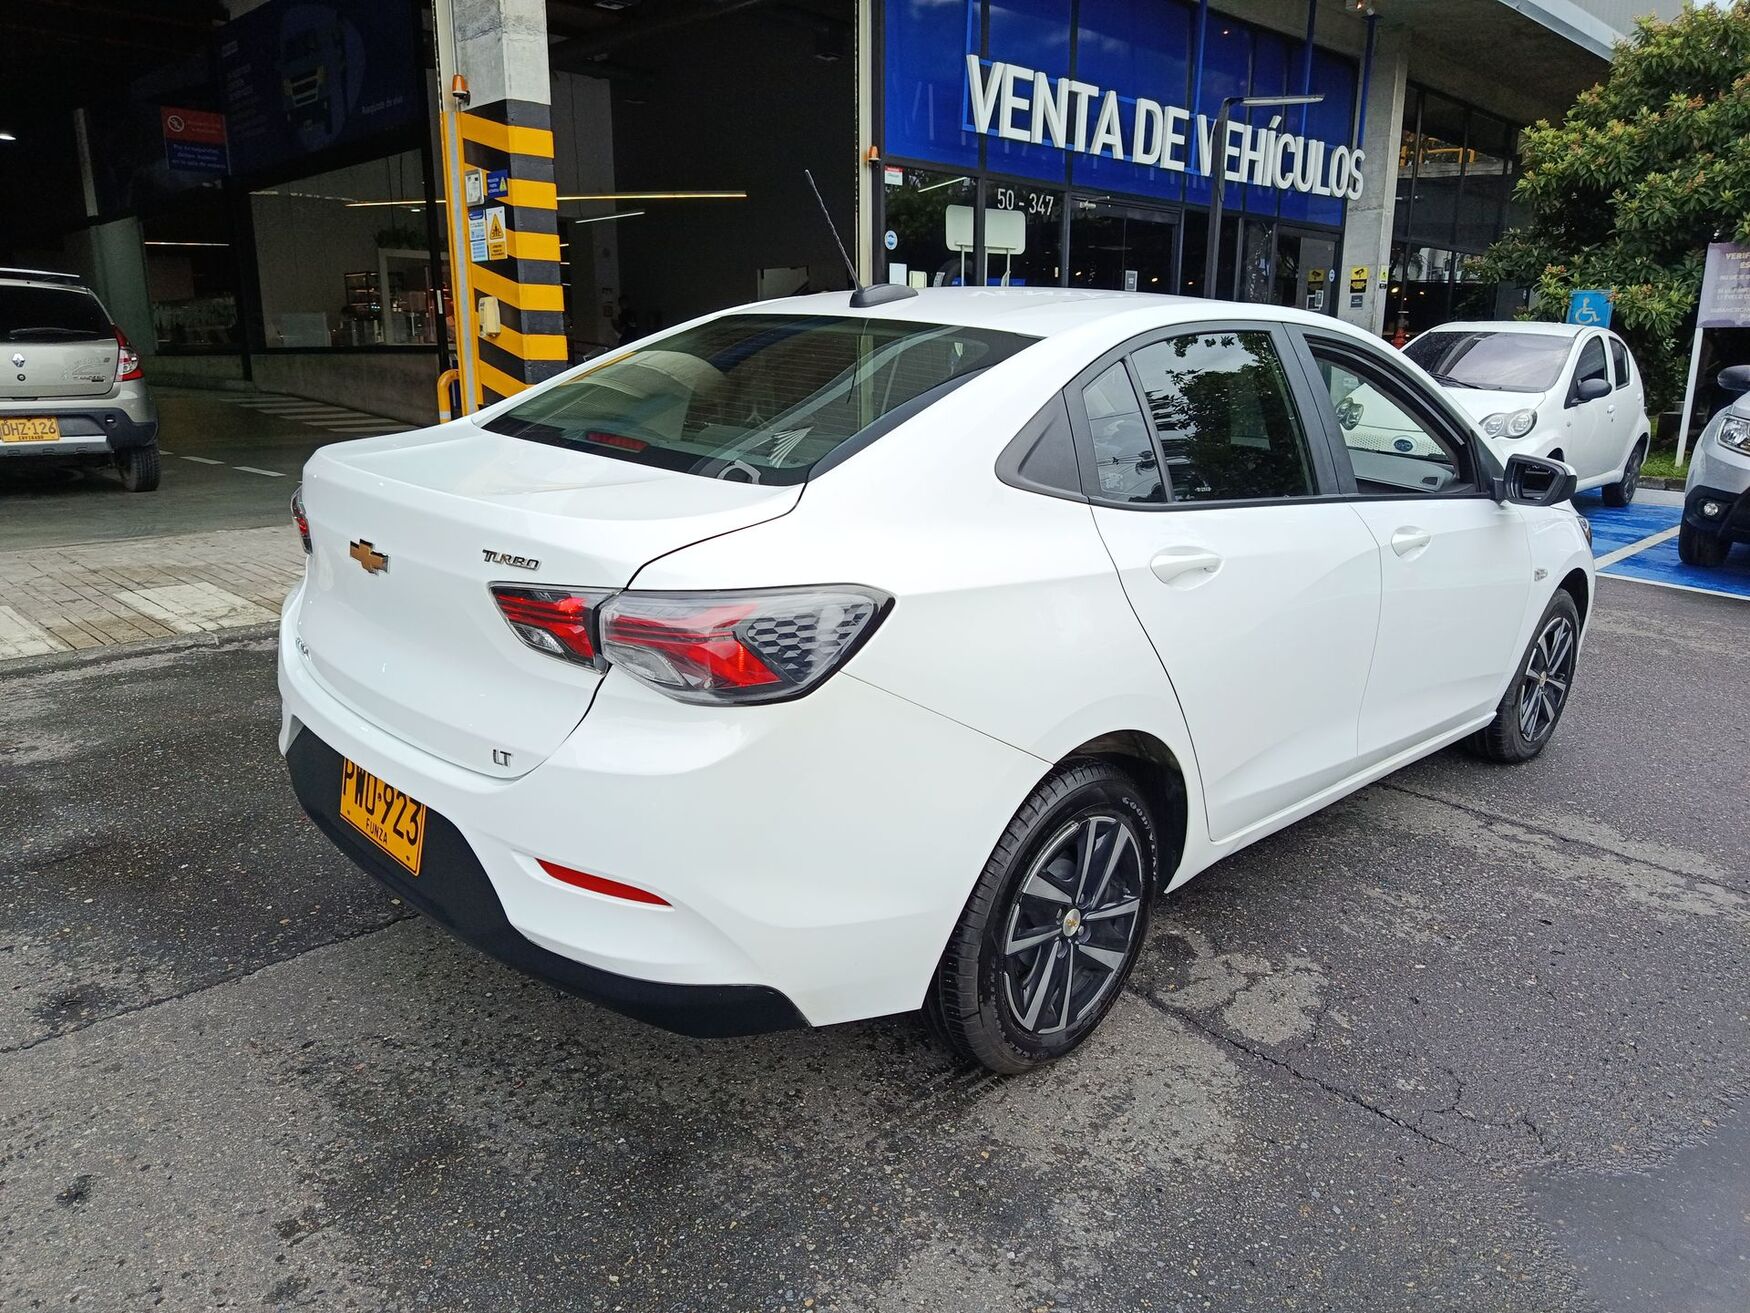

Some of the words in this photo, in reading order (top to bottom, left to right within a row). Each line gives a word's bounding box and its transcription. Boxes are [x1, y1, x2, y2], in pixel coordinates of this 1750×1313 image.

[966, 54, 1124, 160] VENTA
[1132, 98, 1190, 171] DE
[1196, 114, 1366, 201] VEHÍCULOS
[997, 188, 1014, 210] 50
[1029, 193, 1054, 216] 347
[482, 549, 541, 571] TURBO
[493, 749, 512, 767] LT
[365, 817, 388, 845] FUNZA
